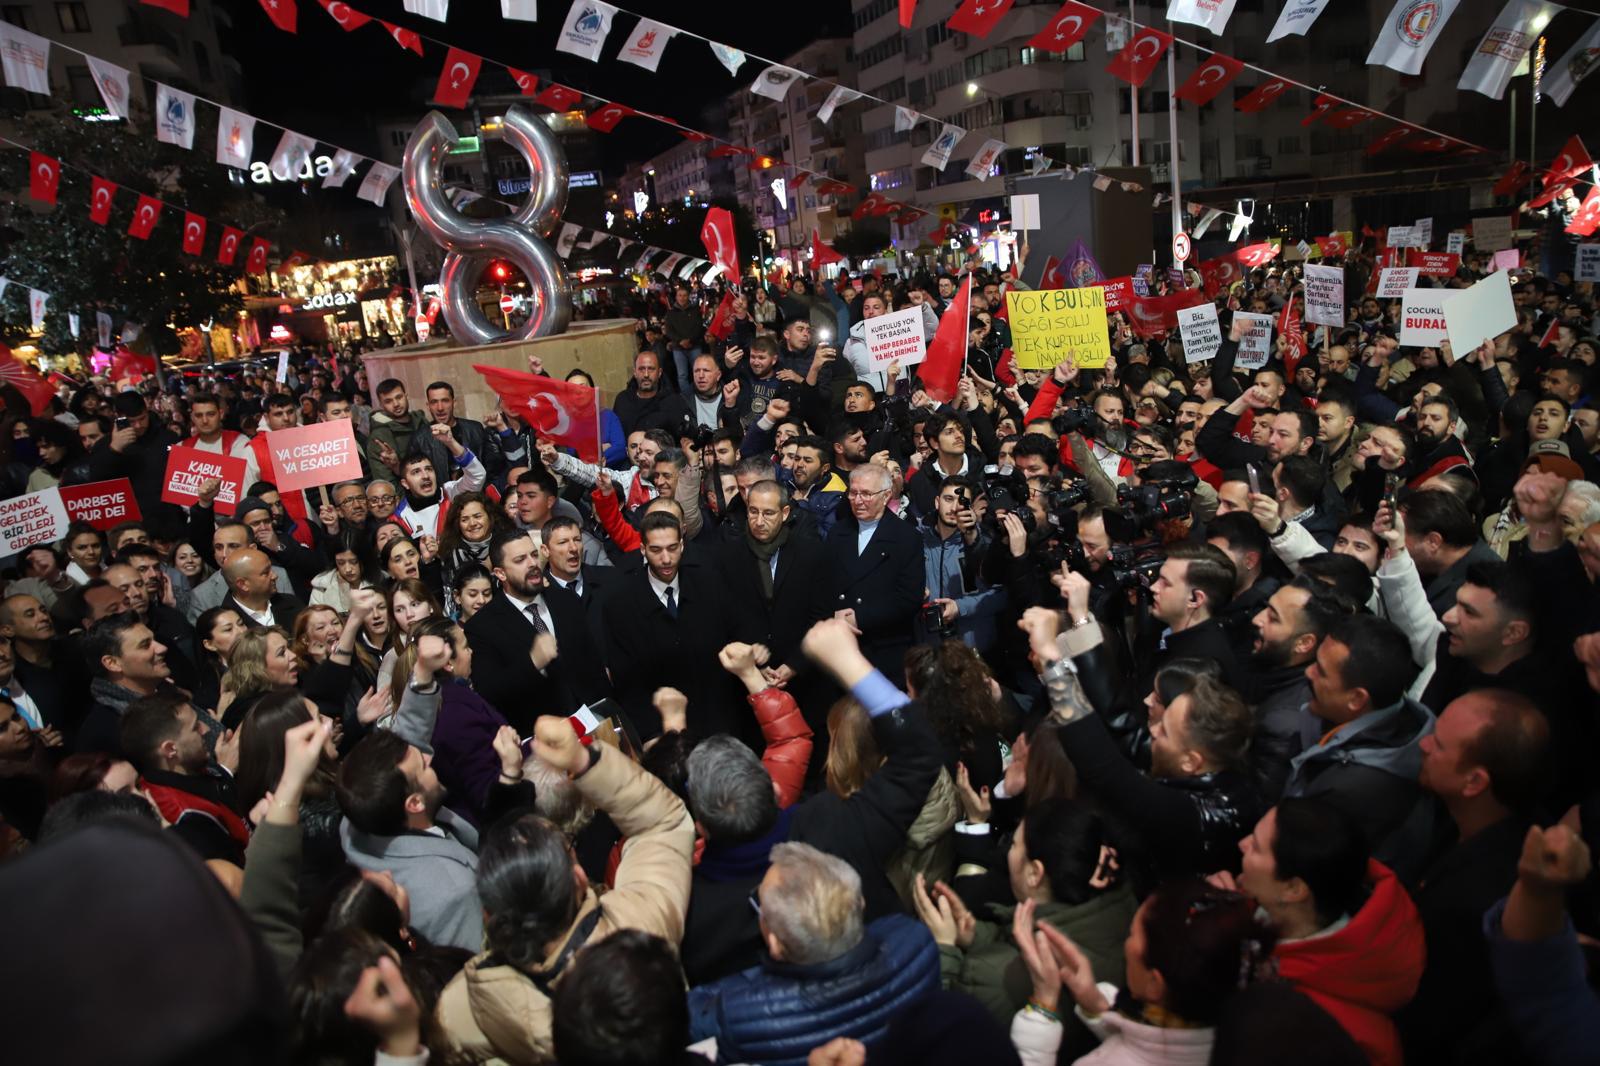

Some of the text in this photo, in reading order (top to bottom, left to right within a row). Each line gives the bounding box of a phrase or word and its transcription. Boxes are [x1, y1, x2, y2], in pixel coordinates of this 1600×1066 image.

[1054, 290, 1076, 310] BU
[1192, 312, 1204, 321] Biz
[1406, 306, 1443, 315] ÇOCUKL
[870, 317, 916, 334] KURTULUŞ YOK
[888, 326, 912, 338] BAŞINA
[1016, 314, 1090, 334] SAĞI SOLU
[879, 342, 892, 351] HEP
[892, 336, 920, 348] BERABER
[1014, 332, 1102, 352] TEK KURTULUŞ
[1187, 334, 1219, 346] Tam Türk
[884, 351, 894, 359] HİÇ
[894, 346, 918, 357] BİRİMİZ
[276, 438, 350, 461] YA CESARET
[188, 460, 224, 478] KABUL
[282, 452, 350, 474] YA ESARET
[172, 470, 237, 494] ETMİYUZ
[0, 496, 41, 516] SANDIK
[67, 492, 126, 511] DARBEYE
[0, 506, 49, 528] GELECEK
[76, 506, 126, 520] DUR DE!
[10, 528, 58, 550] GİDECEK
